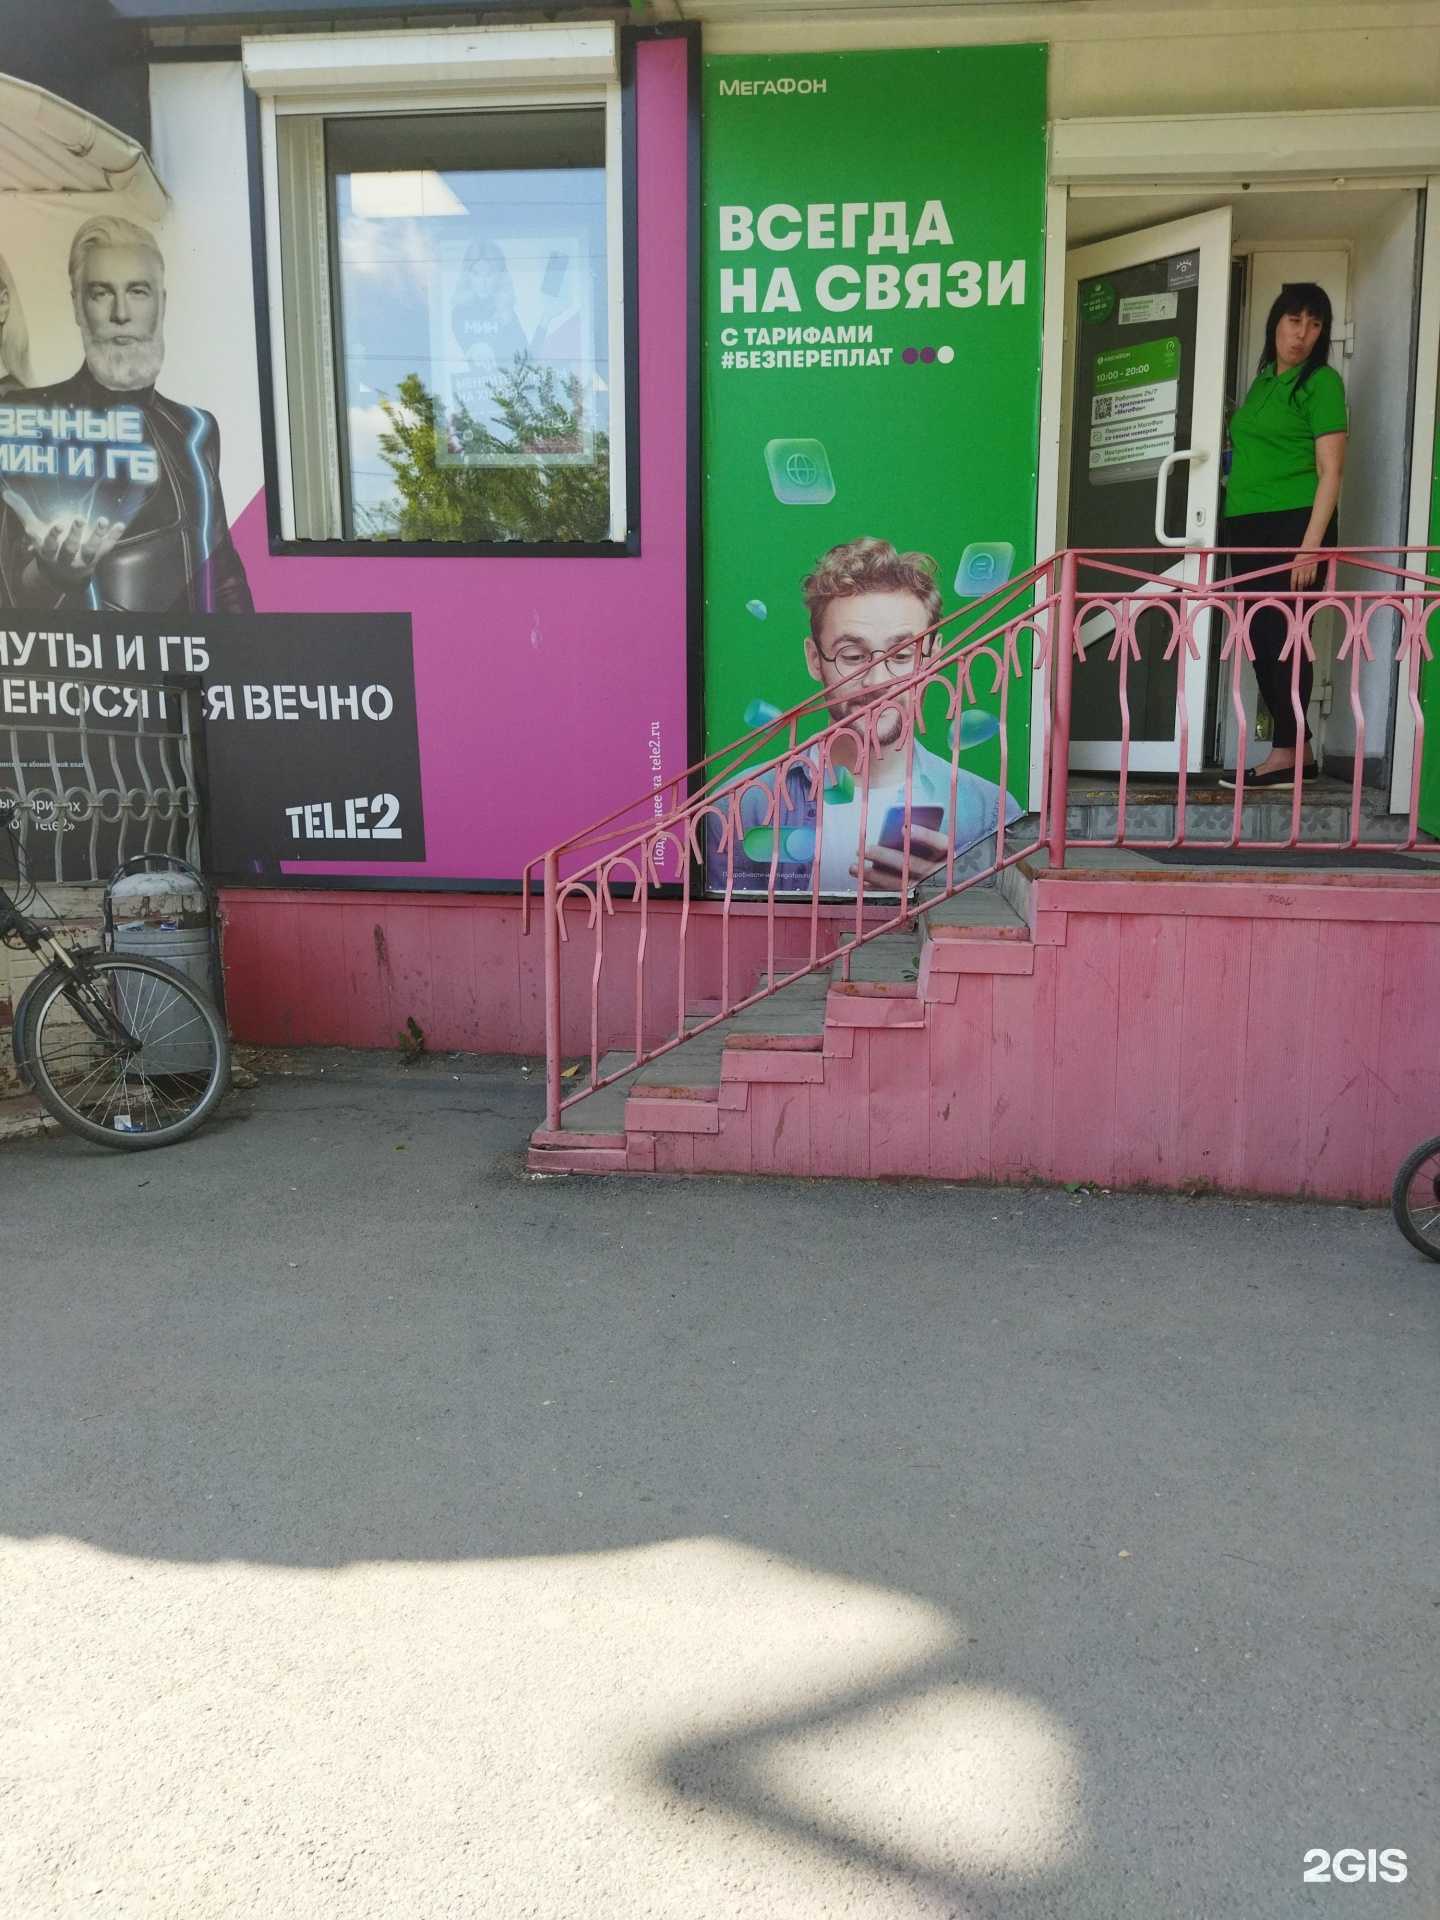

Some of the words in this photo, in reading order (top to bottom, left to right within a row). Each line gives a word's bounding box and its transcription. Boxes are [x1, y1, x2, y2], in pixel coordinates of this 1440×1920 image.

[719, 200, 954, 256] ВСЕГДА
[720, 267, 802, 313] НА
[815, 260, 1026, 313] СВЯЗИ
[720, 328, 739, 346] С
[744, 325, 873, 346] ТАРИФАМИ
[720, 348, 893, 369] #БЕЗПЕРЕПЛАТ
[1125, 364, 1150, 377] 20:00
[68, 447, 95, 477] И
[106, 449, 158, 482] ГБ
[116, 634, 146, 671] И
[159, 636, 210, 672] ГБ
[243, 684, 394, 721] ВЕЧНО
[649, 721, 662, 771] tele2.ru
[285, 793, 403, 839] TELE2
